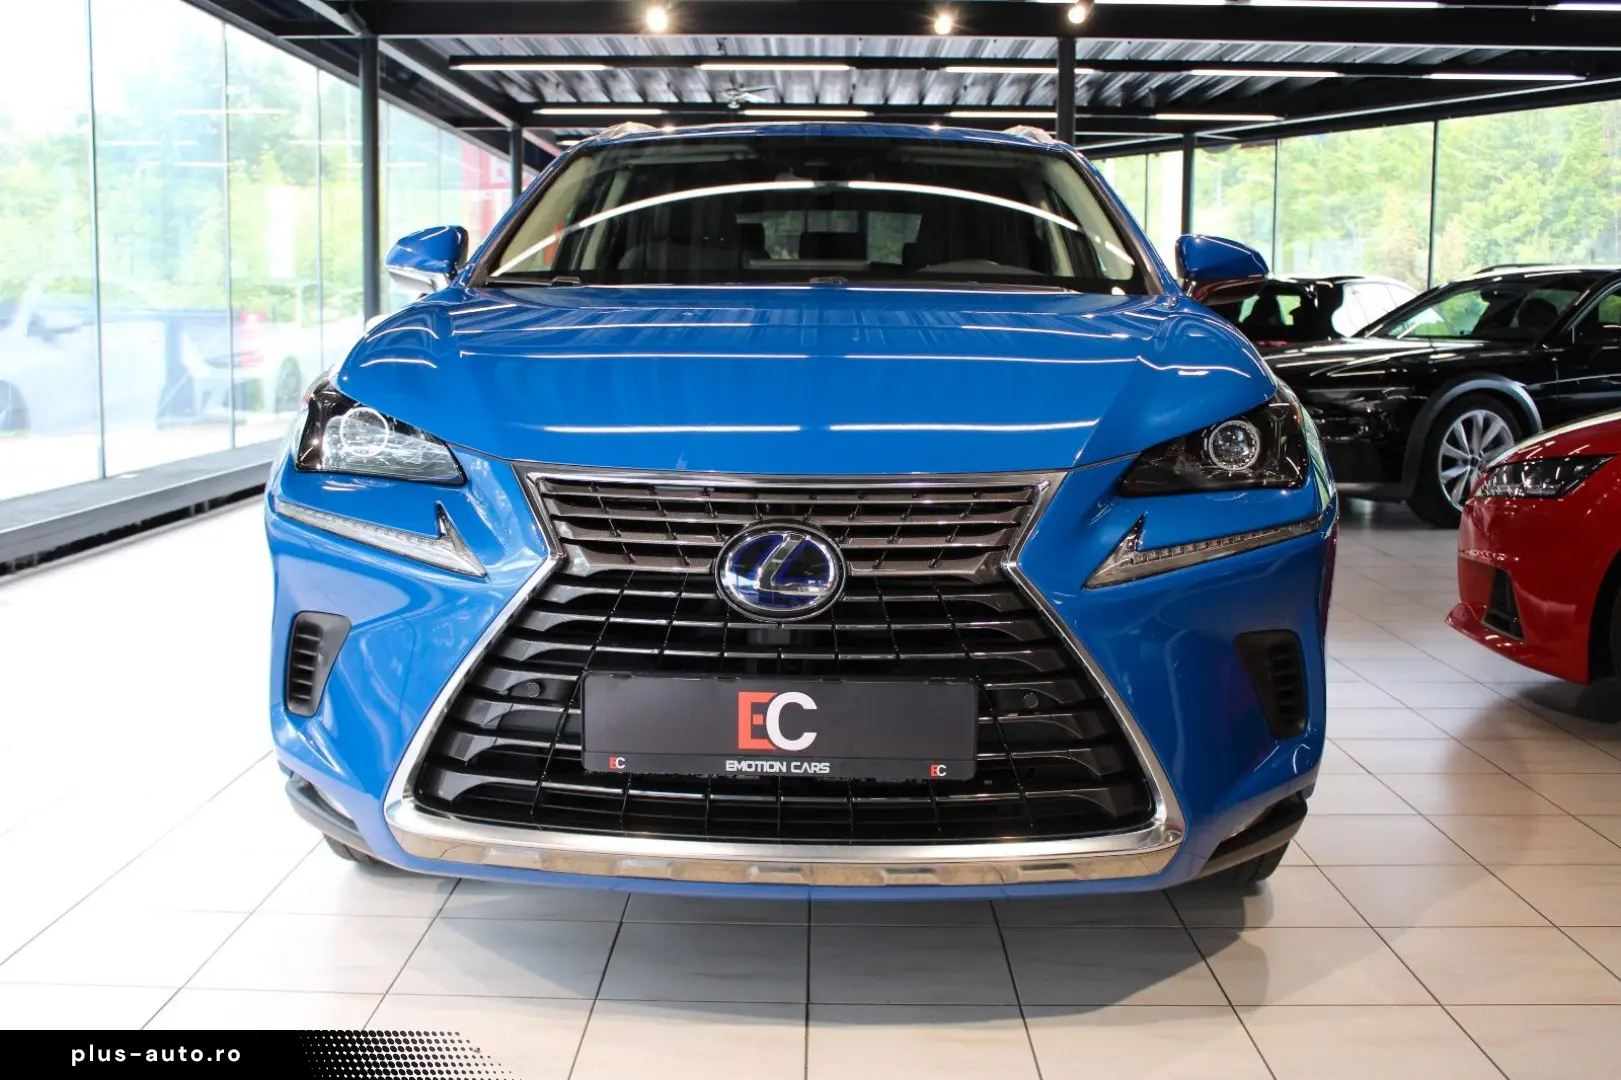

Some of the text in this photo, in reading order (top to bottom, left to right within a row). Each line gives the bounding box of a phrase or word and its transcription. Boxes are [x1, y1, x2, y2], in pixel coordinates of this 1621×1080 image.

[737, 691, 818, 751] EC
[608, 756, 626, 769] EC
[725, 760, 831, 774] EMOTION CARS
[930, 764, 947, 777] EC
